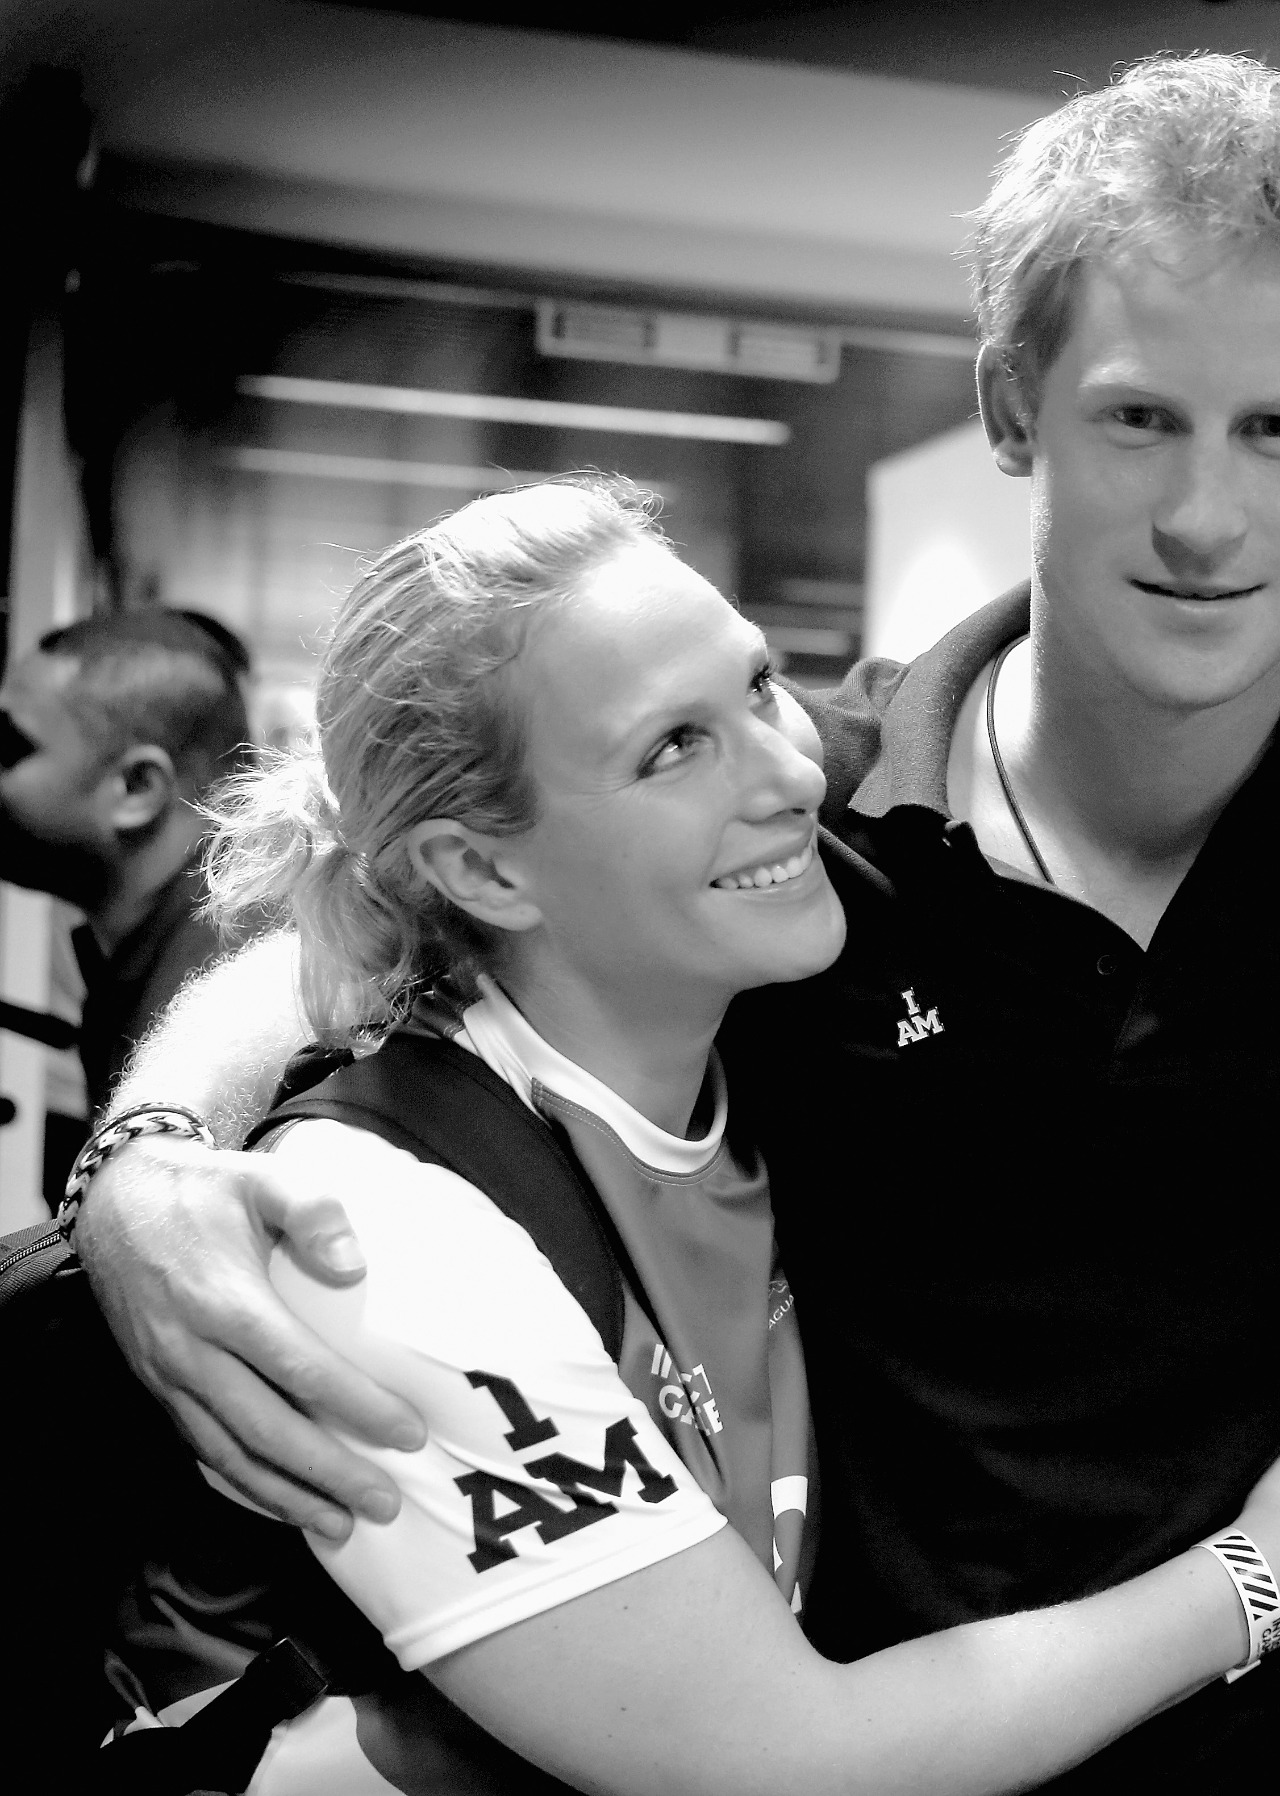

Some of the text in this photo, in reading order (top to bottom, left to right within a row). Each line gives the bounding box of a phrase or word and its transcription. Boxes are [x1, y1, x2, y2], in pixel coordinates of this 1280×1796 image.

[897, 1006, 944, 1047] AM
[901, 986, 920, 1016] I
[463, 1369, 560, 1452] I
[453, 1416, 679, 1574] AM
